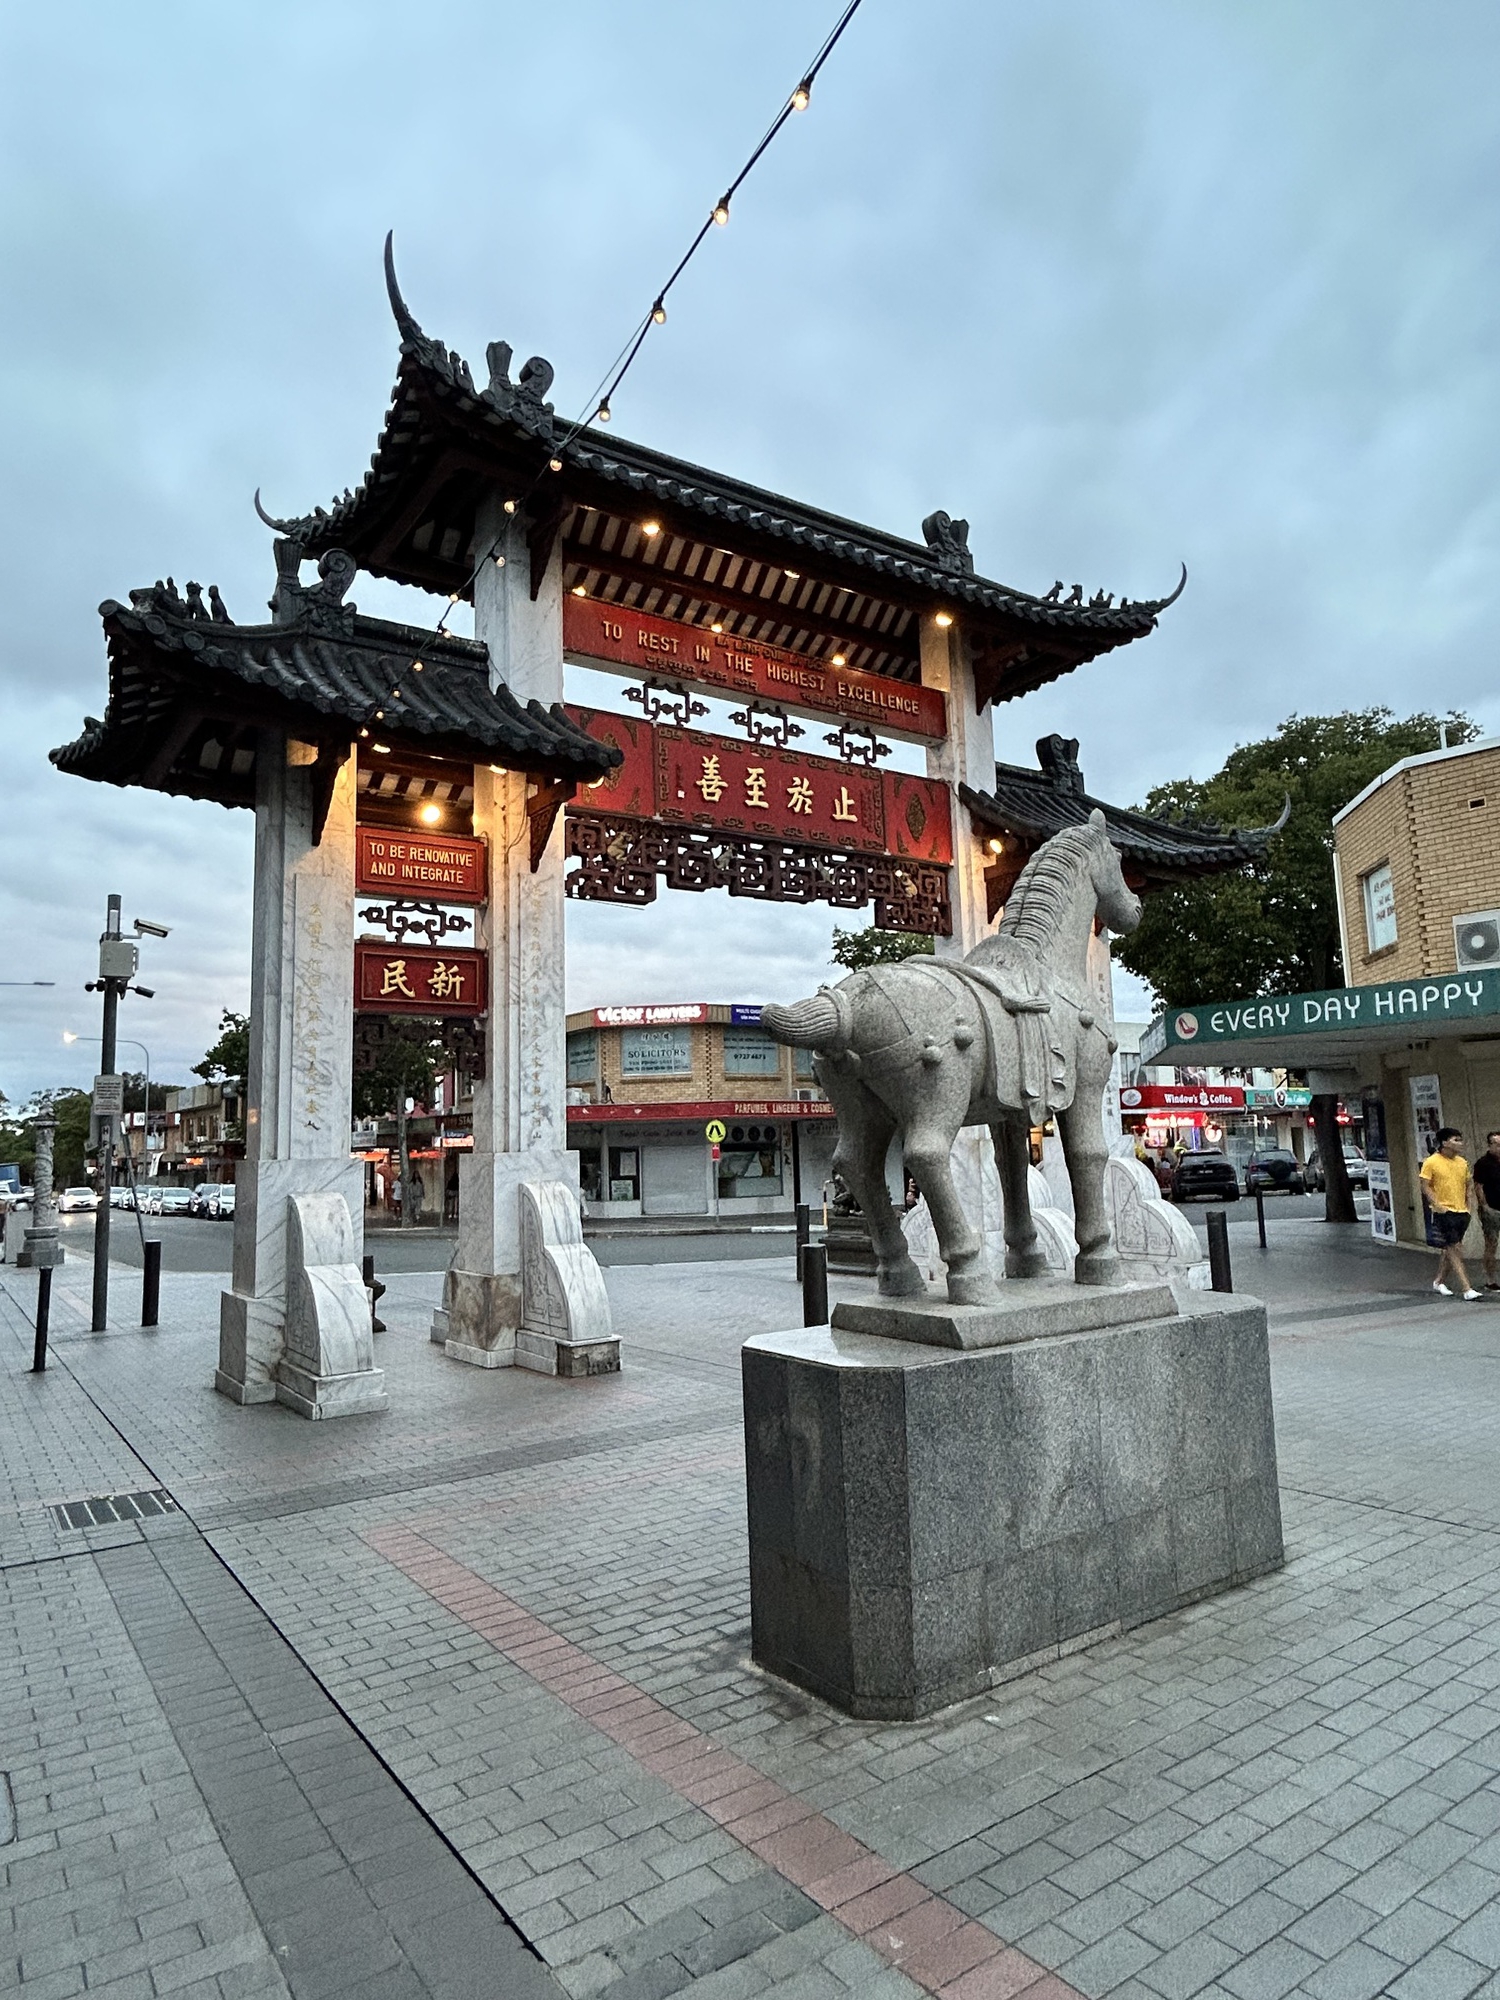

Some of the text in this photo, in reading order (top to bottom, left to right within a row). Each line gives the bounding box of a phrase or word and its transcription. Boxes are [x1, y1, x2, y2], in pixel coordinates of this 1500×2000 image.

[602, 621, 623, 640] TO
[638, 629, 680, 654] REST
[695, 645, 711, 662] IN
[725, 652, 754, 674] THE
[767, 663, 826, 692] HIGHEST
[837, 681, 921, 716] EXCELLENCE
[369, 842, 473, 868] TO BE RENOVATIVE
[370, 862, 464, 884] AND INTEGRATE
[1210, 980, 1484, 1034] EVERY DAY HAPPY
[628, 1048, 686, 1059] SOLICITORS
[772, 1103, 800, 1113] LINGERIE
[803, 1103, 808, 1113] &
[1209, 1093, 1233, 1104] Coffee
